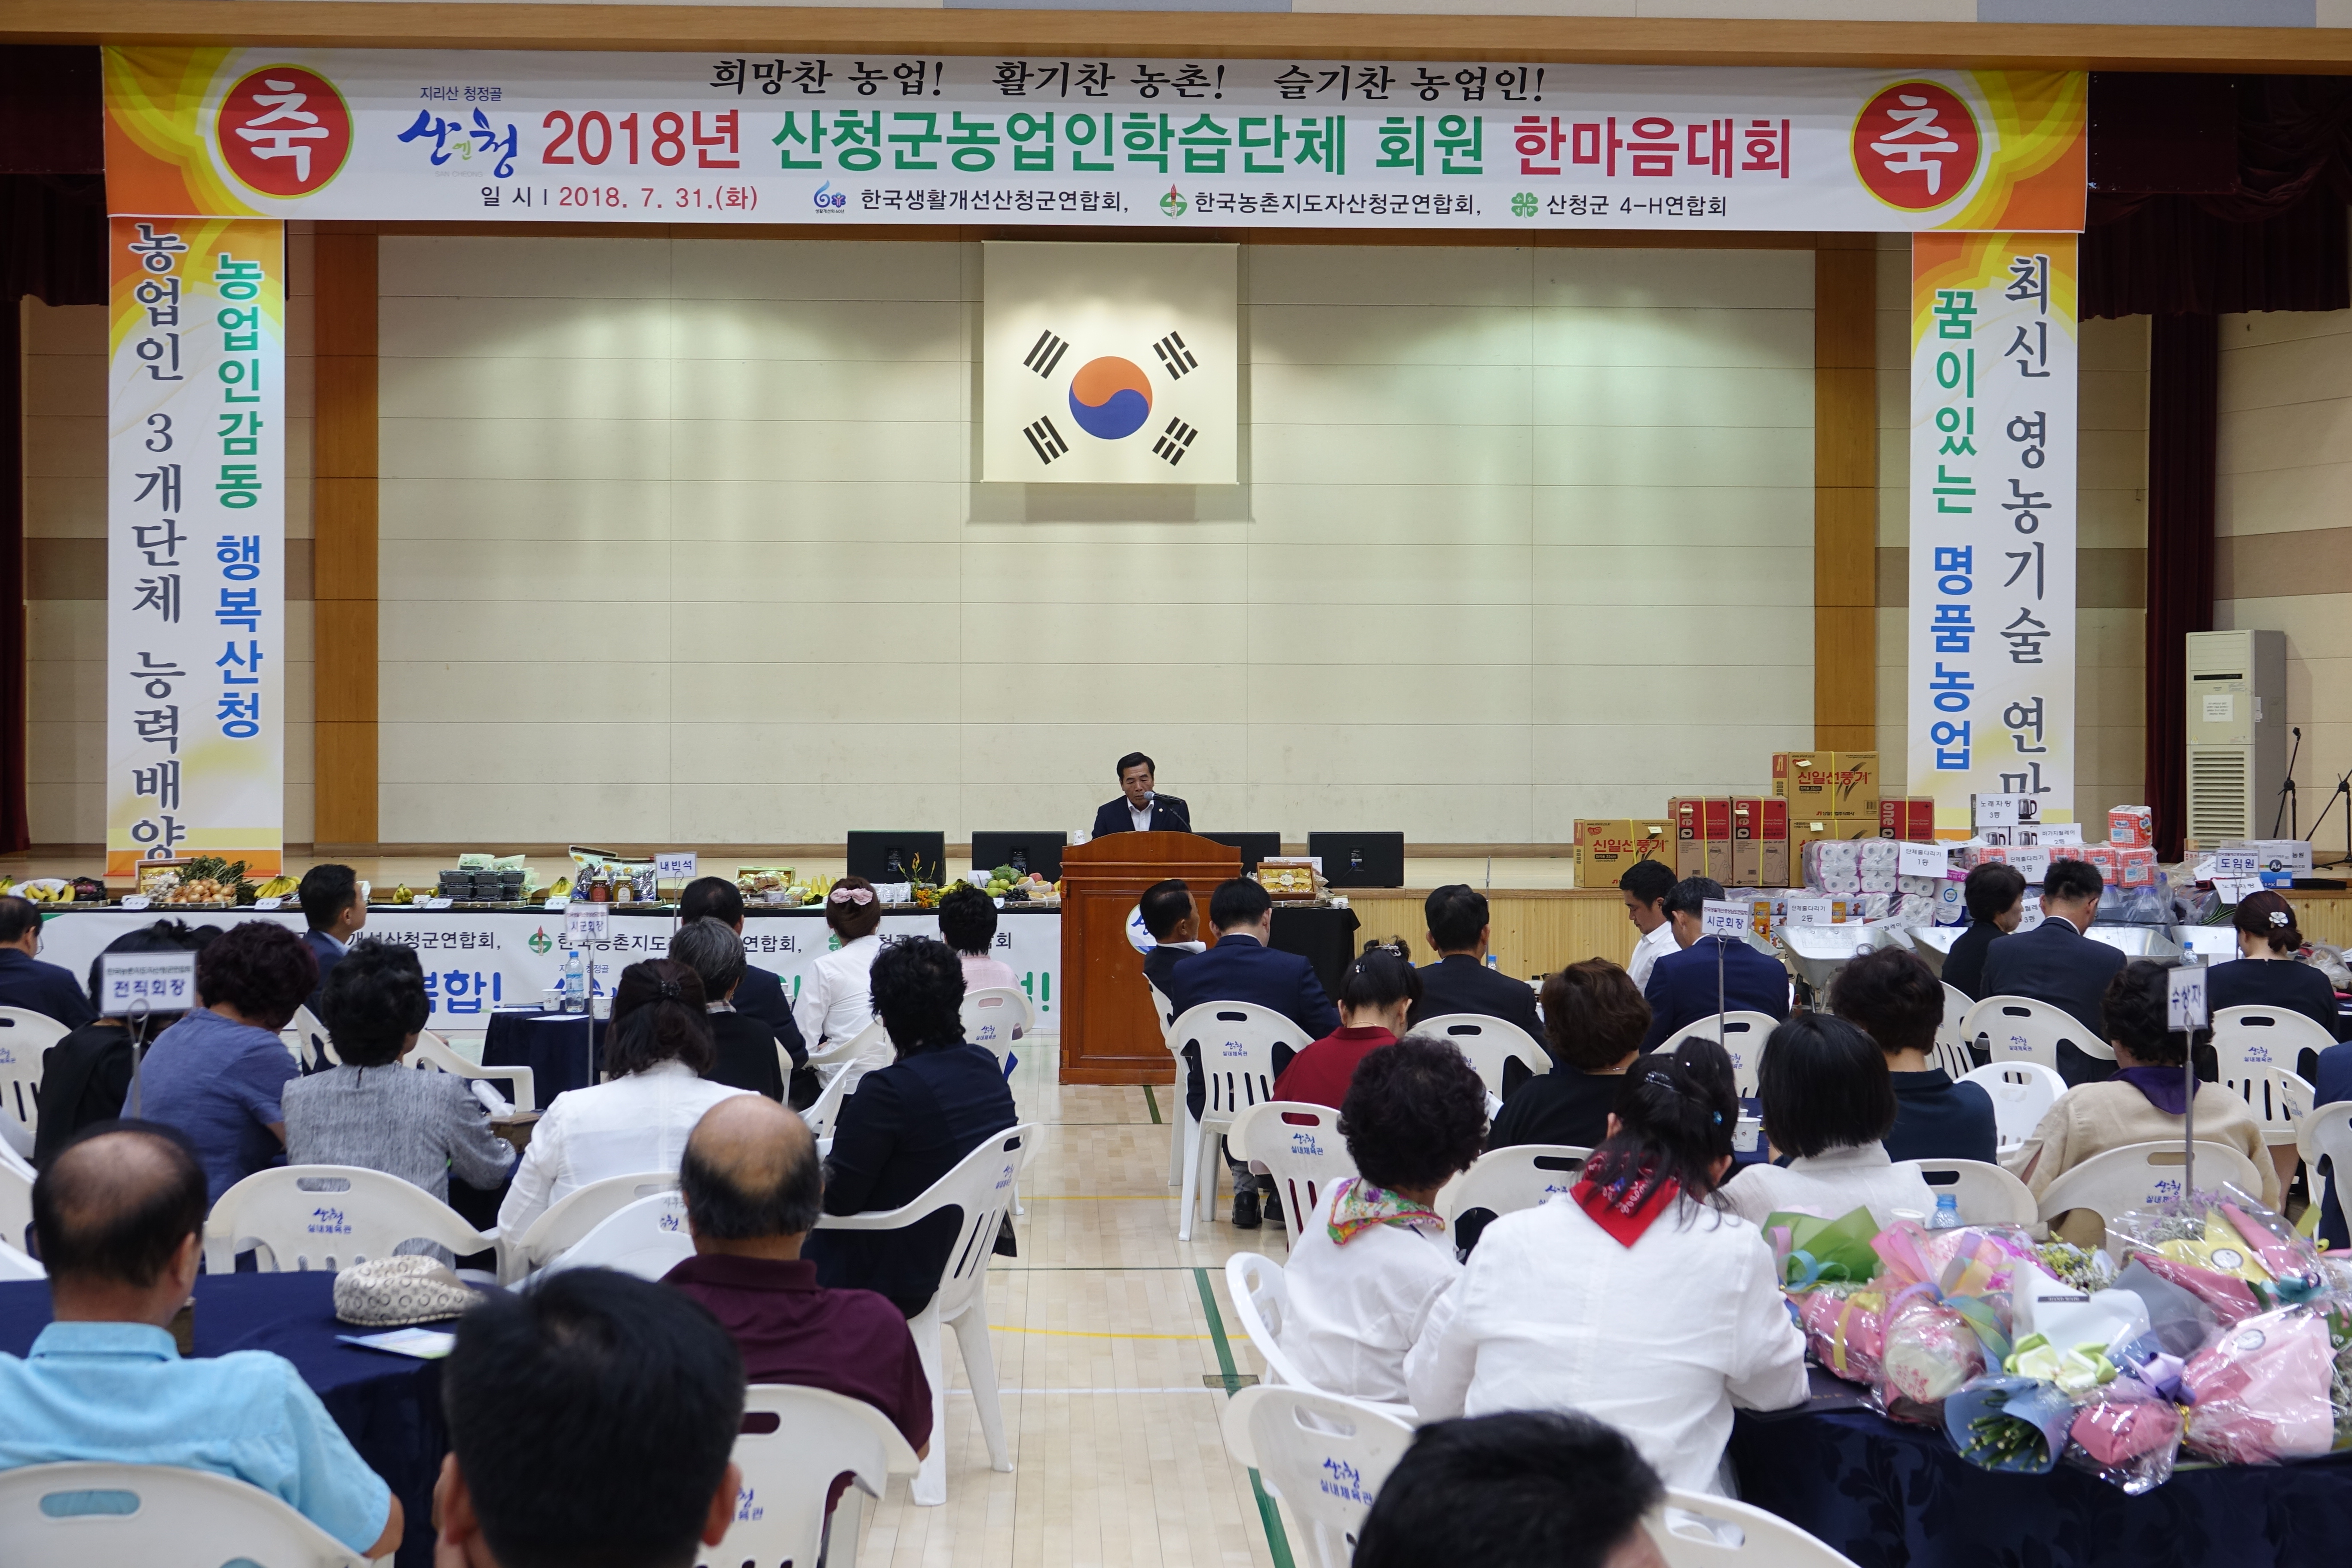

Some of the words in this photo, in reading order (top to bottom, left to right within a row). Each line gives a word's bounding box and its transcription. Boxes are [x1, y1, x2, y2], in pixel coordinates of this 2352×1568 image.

[710, 58, 833, 96] 희망찬
[847, 60, 943, 97] 농업!
[992, 61, 1115, 98] 활기찬
[1130, 64, 1225, 99] 농촌!
[1273, 64, 1396, 101] 슬기찬
[1410, 67, 1545, 103] 농업인!
[420, 86, 459, 101] 지리산
[464, 86, 502, 101] 청정골
[235, 79, 329, 183] 축
[542, 109, 741, 170] 2018년
[772, 109, 1346, 174] 산청군농업인학습단체
[1376, 113, 1484, 175] 회원
[1513, 116, 1791, 179] 한마음대회
[1870, 94, 1960, 196] 축
[560, 187, 628, 208] 2018.
[642, 188, 663, 209] 7.
[861, 188, 1128, 213] 한국생활개선산청군연합회,
[1195, 192, 1482, 217] 한국농촌지도자산청군연합회,
[1547, 195, 1609, 217] 산청군
[130, 224, 187, 380] 농업인
[2005, 256, 2051, 377] 최신
[215, 254, 263, 508] 농업인감동
[1932, 291, 1978, 514] 꿈이있는
[131, 413, 187, 624] 3개단체
[2000, 411, 2052, 664] 영농기술
[215, 535, 263, 738] 행복산청
[1930, 545, 1975, 770] 명품농업
[130, 652, 186, 860] 능력배양
[2000, 696, 2051, 794] 연마
[1798, 771, 1868, 785] 신일선풍기
[1738, 803, 1749, 825] oe
[1883, 802, 1895, 825] one
[1593, 839, 1665, 853] 신일선풍기
[1906, 848, 1942, 857] 단체줄다리기
[660, 860, 692, 871] 내빈석
[2221, 858, 2254, 869] 도임원
[571, 921, 603, 932] 시군회장
[1707, 916, 1744, 929] 시군회장
[114, 979, 185, 998] 전직회장
[2171, 984, 2201, 1010] 수상자
[1291, 1147, 1323, 1155] 실내체육관
[307, 1224, 352, 1234] 실내체육관
[1320, 1478, 1373, 1506] 실내체육관
